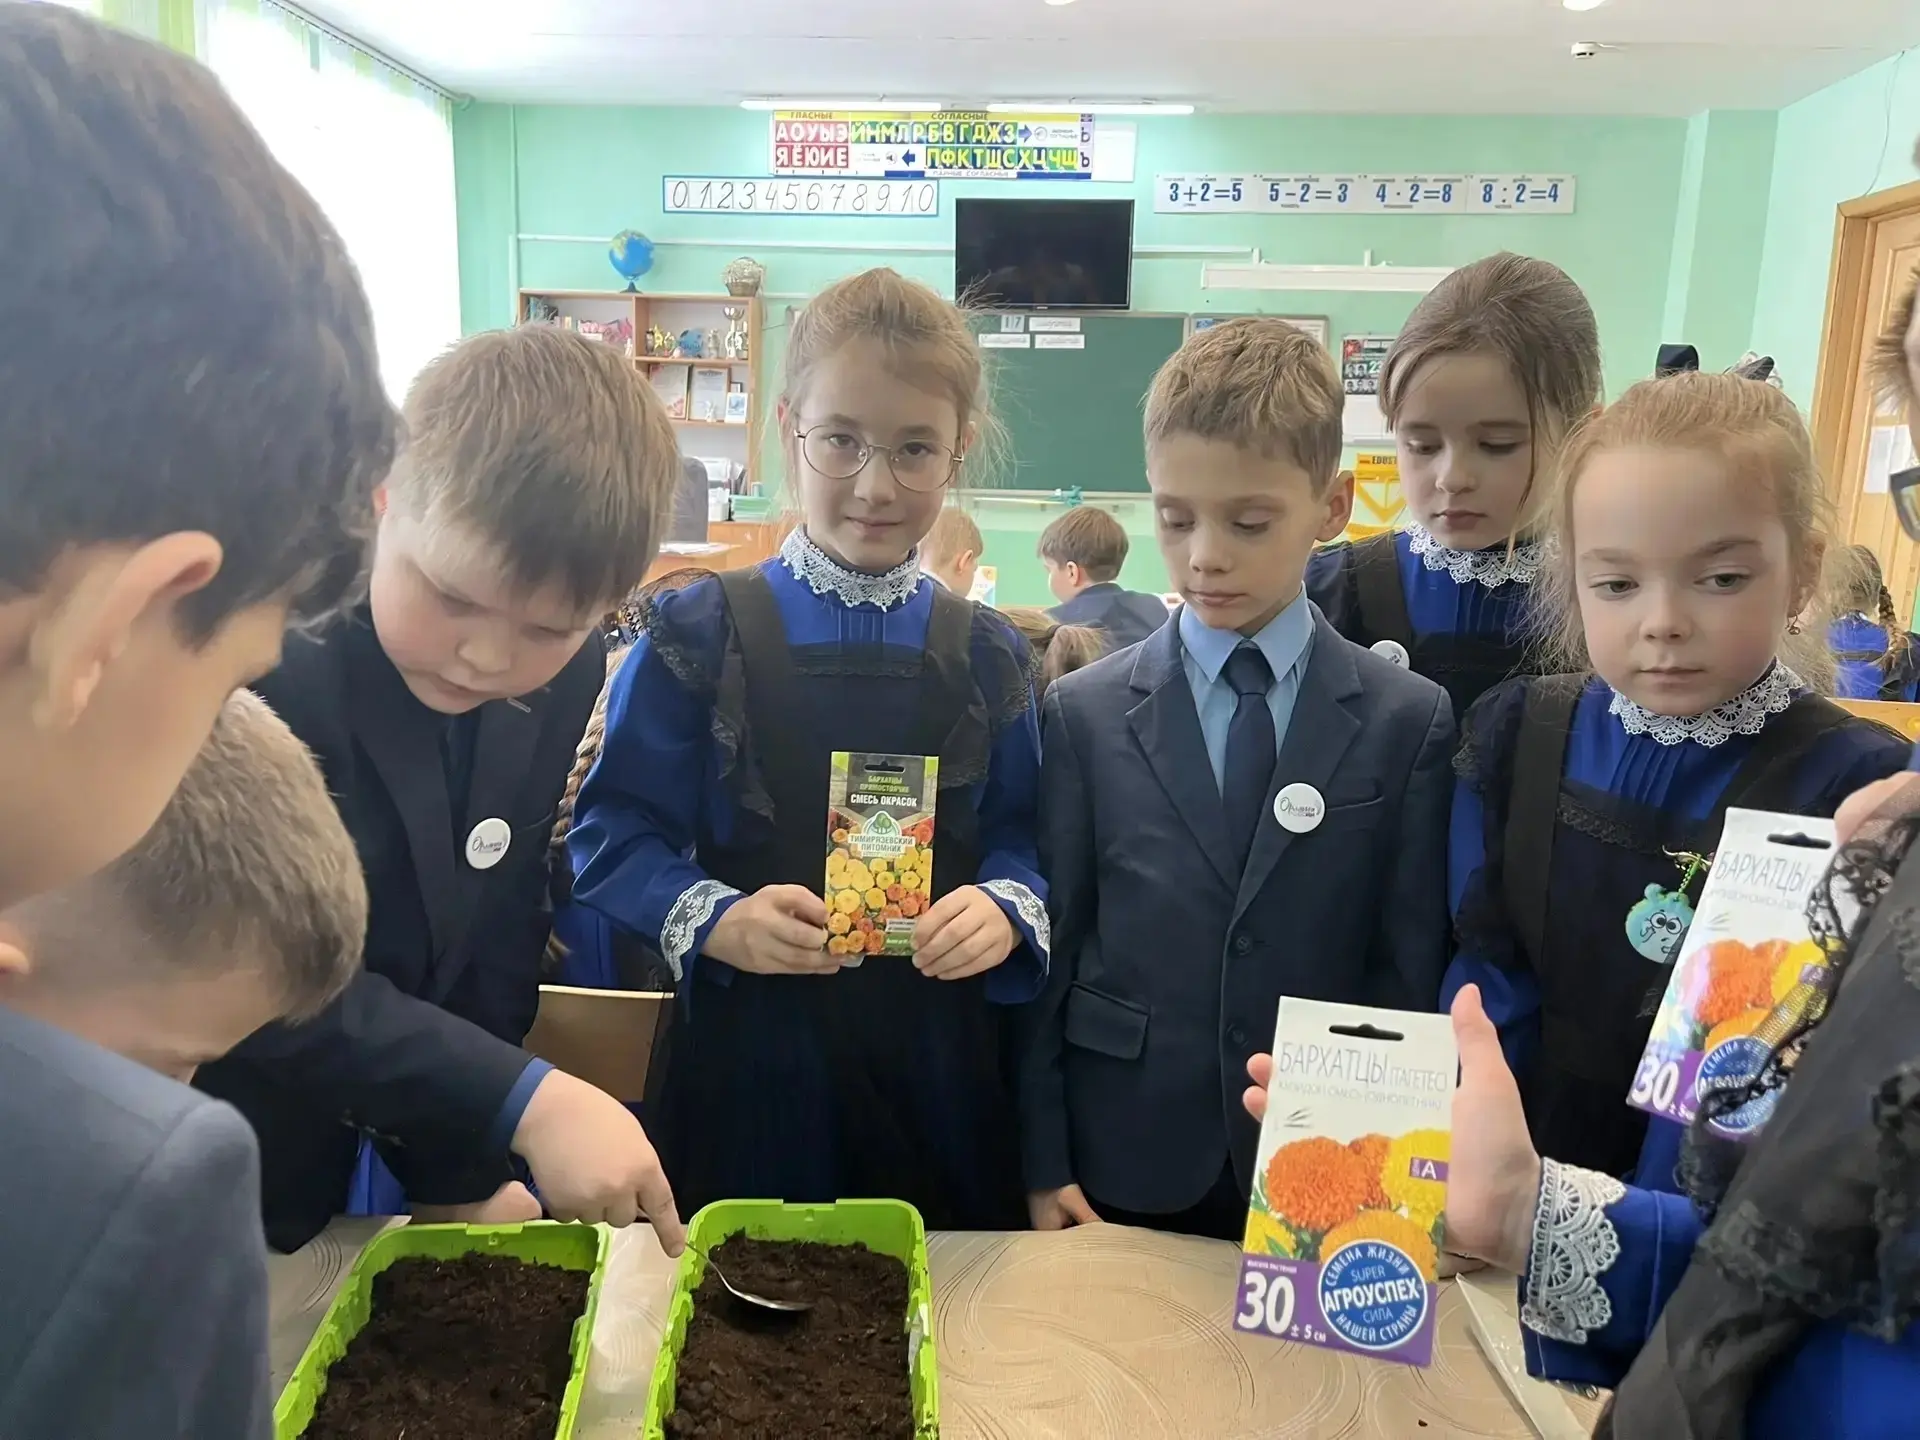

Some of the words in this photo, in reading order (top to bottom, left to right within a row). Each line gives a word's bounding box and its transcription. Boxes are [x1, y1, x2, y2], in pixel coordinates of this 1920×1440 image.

[790, 111, 833, 119] ГЛАСНЫЕ
[931, 112, 988, 120] СОГЛАСНЫЕ
[850, 793, 879, 804] СМЕСЬ
[880, 795, 917, 807] ОКРАСОК
[861, 843, 901, 852] ПИТОМНИК
[1715, 851, 1808, 896] БАРХАТЦЫ
[1279, 1042, 1388, 1087] БАРХАТЦЫ
[1630, 1055, 1679, 1112] 30
[1325, 1245, 1362, 1287] СЕМЕНА
[1367, 1245, 1411, 1275] ЖИЗНИ
[1350, 1265, 1386, 1283] SUPER
[1237, 1271, 1295, 1334] 30
[1323, 1277, 1420, 1313] АГРОУСПЕХ
[1336, 1313, 1376, 1342] НАШЕЙ
[1379, 1304, 1418, 1341] СТРАНЫ
[1362, 1306, 1394, 1325] СИЛА
